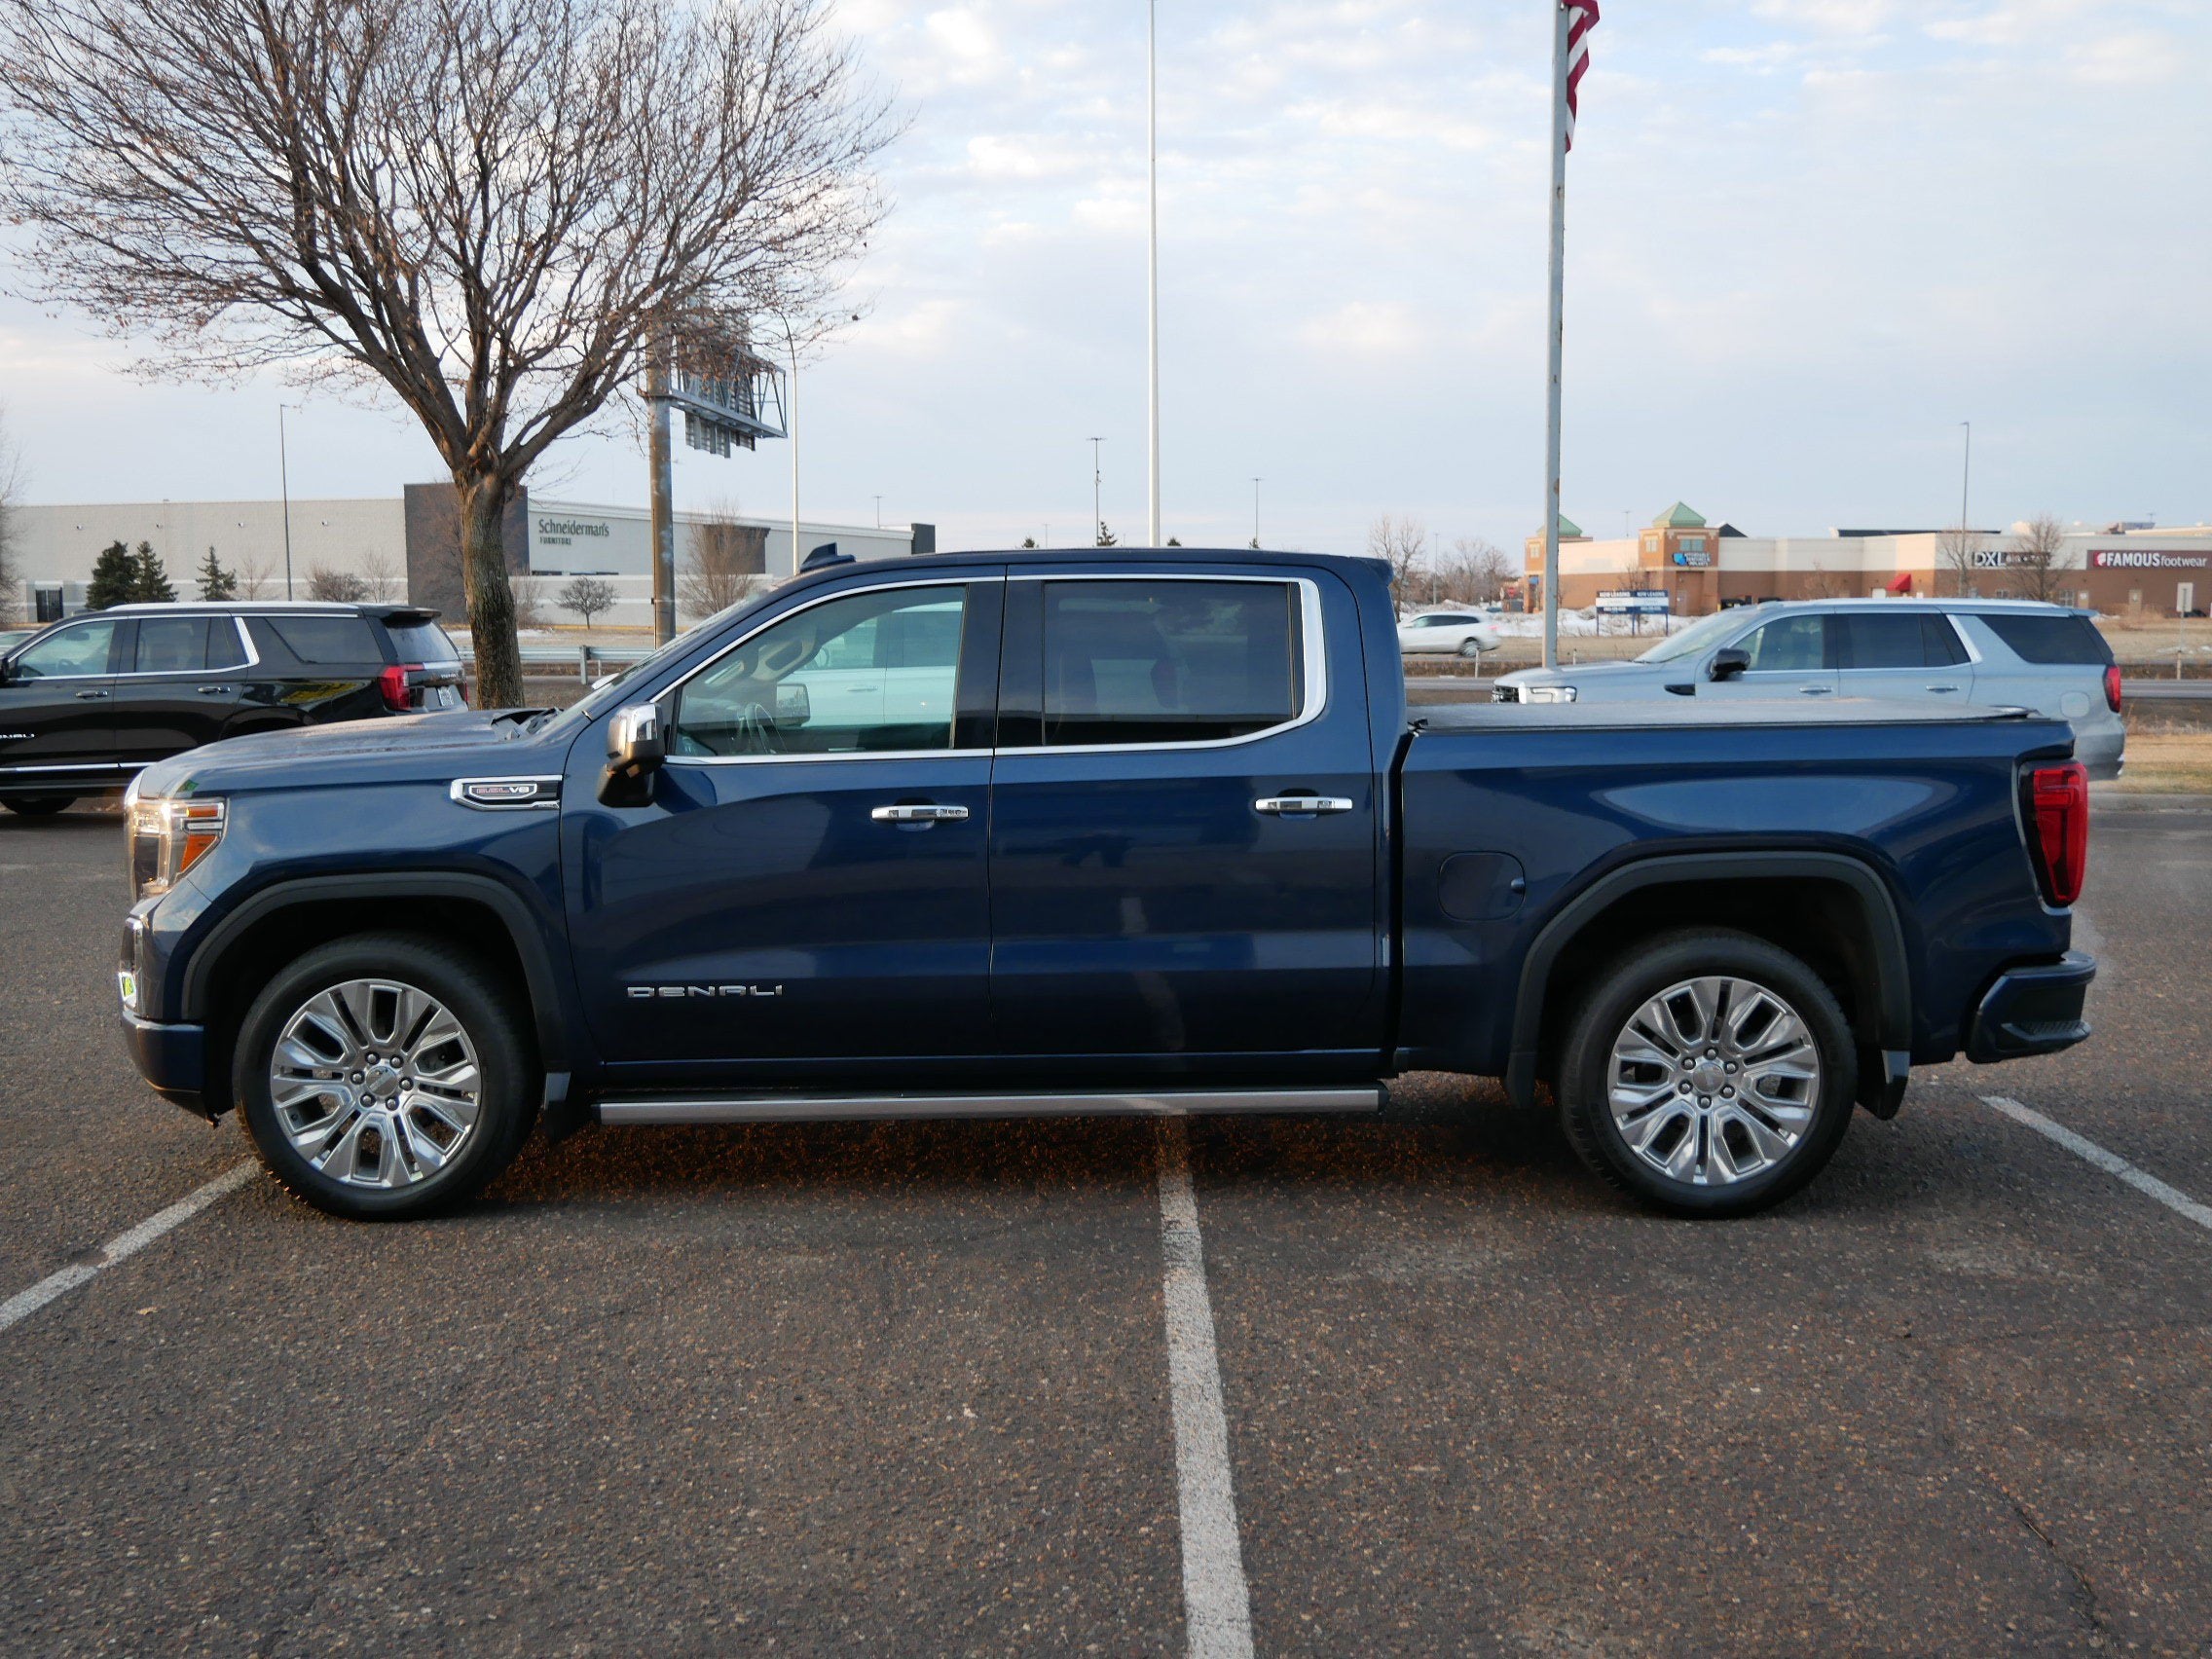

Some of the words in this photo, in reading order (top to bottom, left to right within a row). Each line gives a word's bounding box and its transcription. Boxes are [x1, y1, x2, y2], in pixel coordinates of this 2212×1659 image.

[538, 519, 609, 536] Schneiderman's
[1973, 551, 2006, 566] DXL
[2106, 552, 2160, 567] FAMOUS
[2160, 555, 2207, 568] footwear
[626, 984, 784, 998] DENALI
